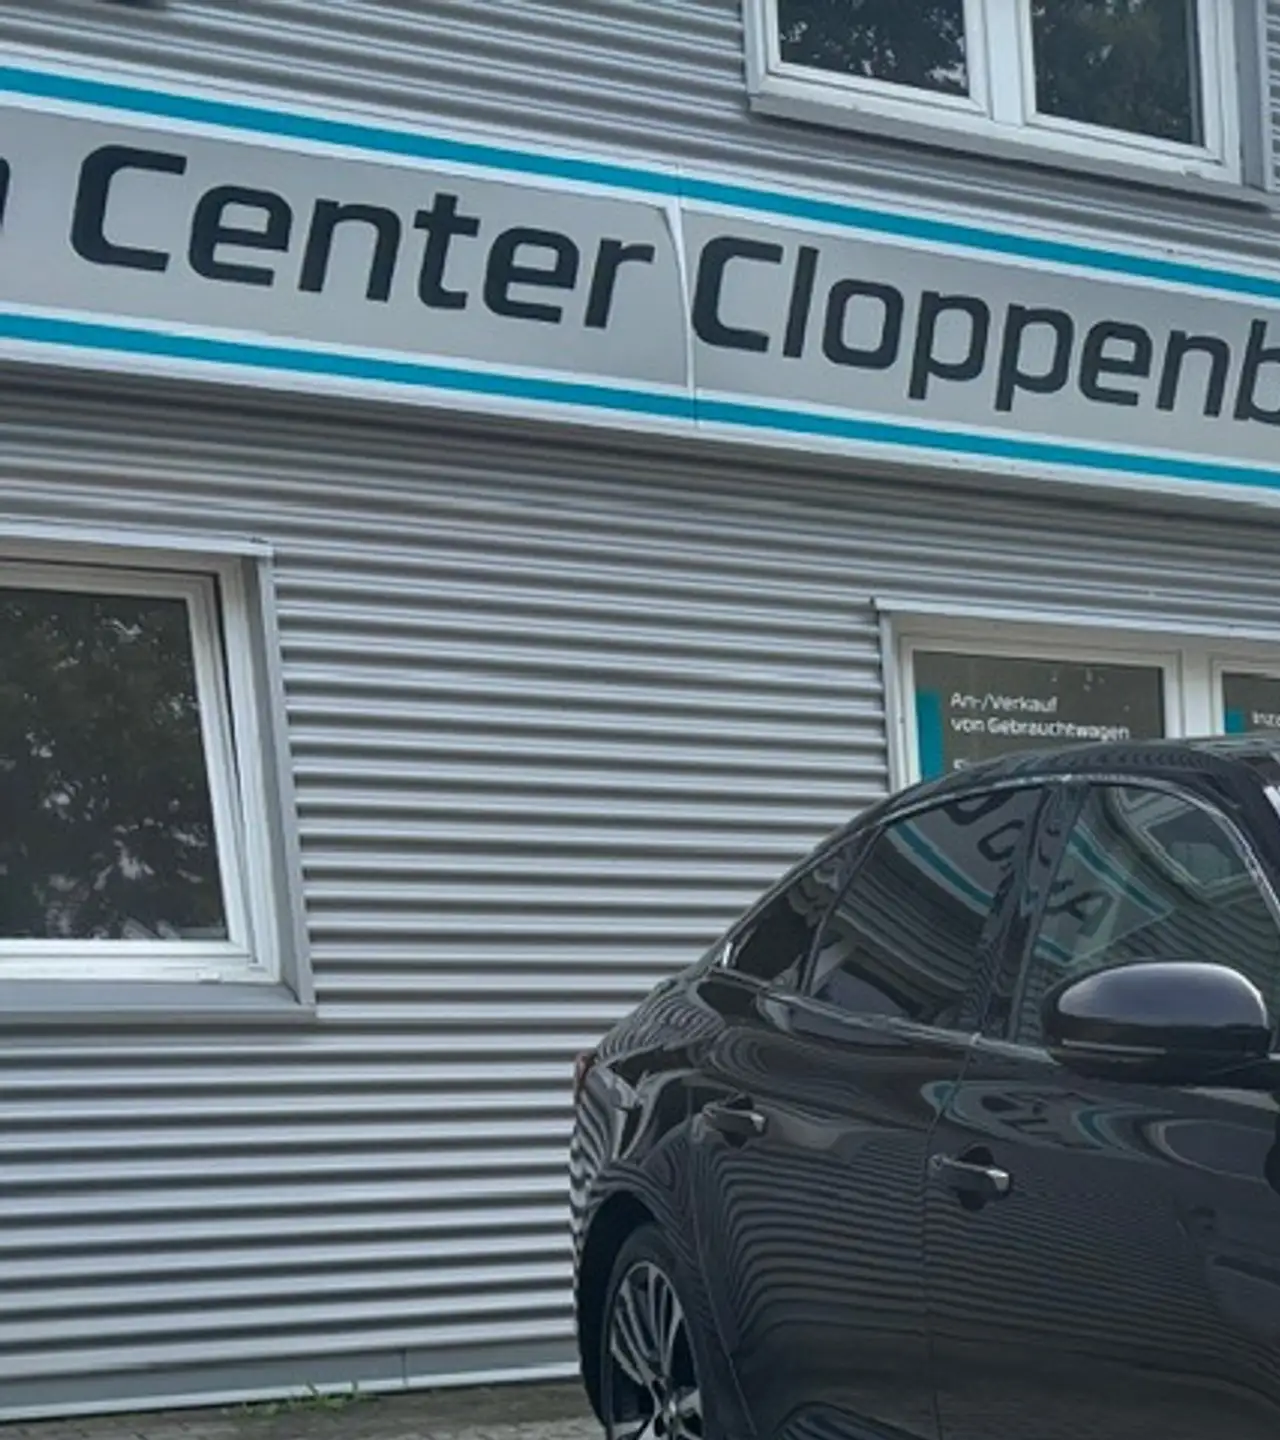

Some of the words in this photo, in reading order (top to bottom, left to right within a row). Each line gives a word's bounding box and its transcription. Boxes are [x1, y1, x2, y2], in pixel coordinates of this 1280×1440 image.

[69, 144, 655, 329] Center
[951, 717, 985, 733] von
[986, 716, 1130, 742] Gebrauchtwagen
